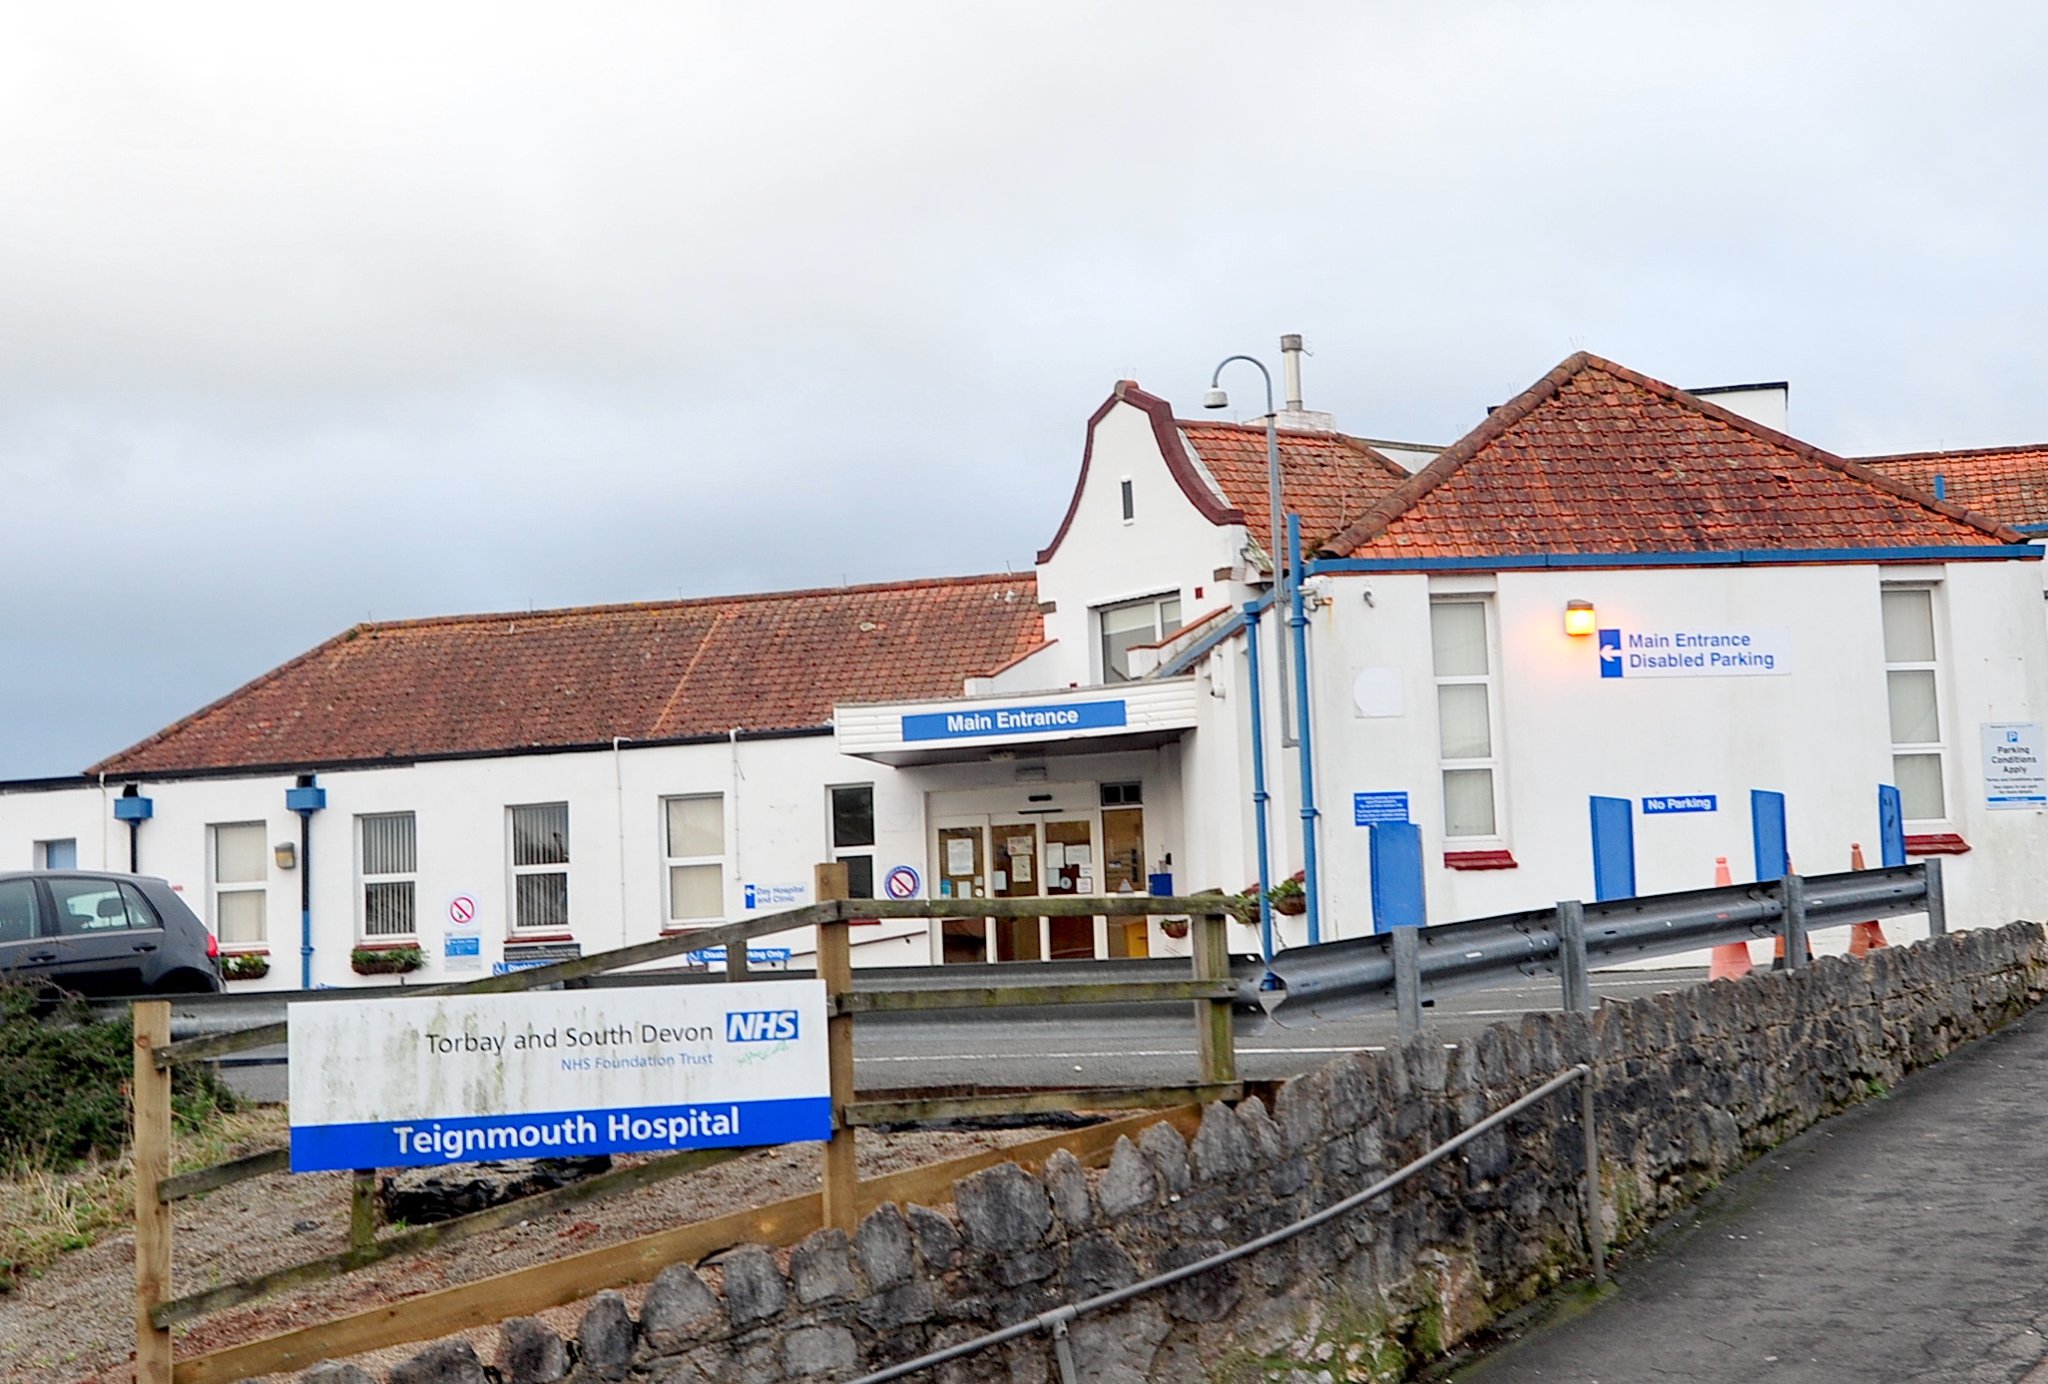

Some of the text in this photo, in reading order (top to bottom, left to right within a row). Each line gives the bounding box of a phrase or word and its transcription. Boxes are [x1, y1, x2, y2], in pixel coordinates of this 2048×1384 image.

[1629, 633, 1751, 648] Main Entrance
[1630, 652, 1775, 669] Disabled Parking
[946, 710, 1079, 732] Main Entrance
[1997, 746, 2030, 754] Parking
[2003, 766, 2027, 774] Apply
[1648, 797, 1712, 810] No Parking
[773, 886, 804, 894] Hospital
[773, 895, 796, 903] Clinic
[728, 1011, 796, 1040] NHS
[425, 1024, 713, 1056] Torbay and South Devon
[561, 1053, 713, 1071] NHS Foundation Trust
[393, 1106, 739, 1159] Teignmouth Hospital
